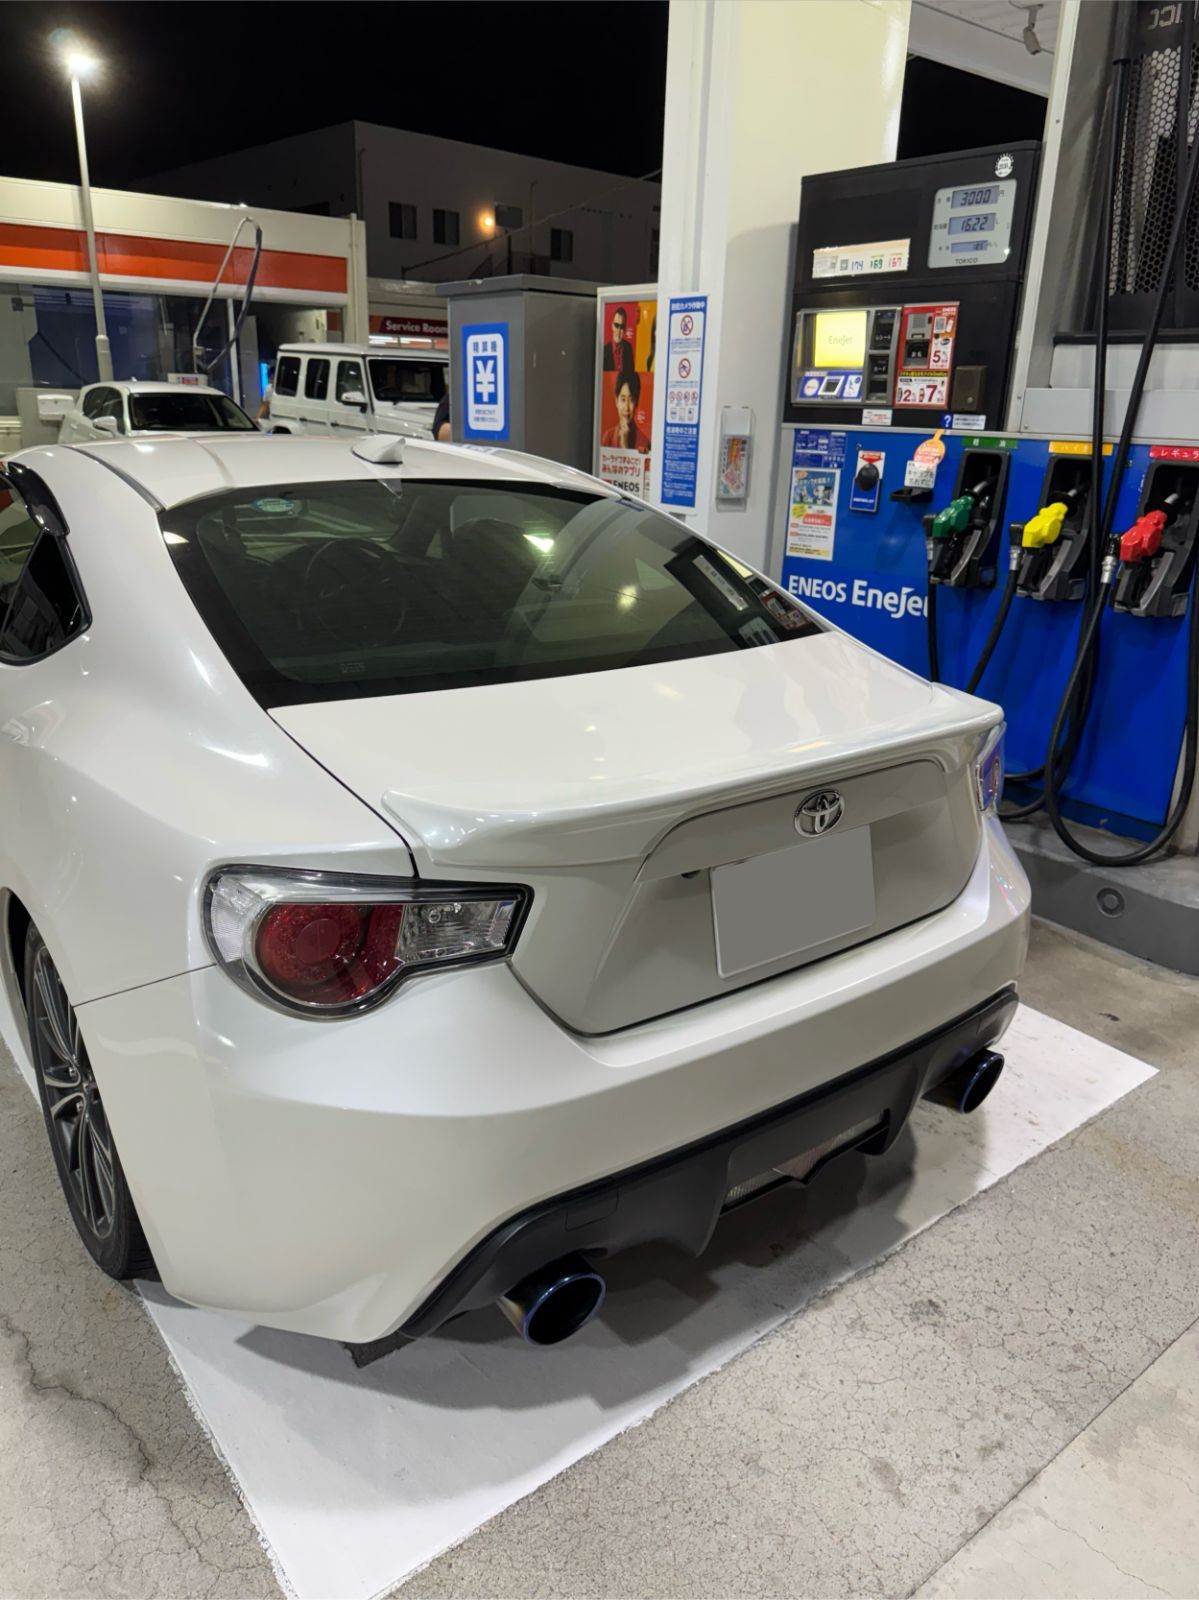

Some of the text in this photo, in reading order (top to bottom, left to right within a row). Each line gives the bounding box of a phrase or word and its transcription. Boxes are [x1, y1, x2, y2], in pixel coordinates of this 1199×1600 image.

[960, 189, 991, 207] 3000
[386, 320, 421, 332] Service
[932, 351, 941, 364] 5
[903, 384, 938, 402] 2 7
[1160, 448, 1199, 459] レギュラ
[613, 480, 640, 493] ENEOS
[788, 575, 847, 603] ENEOS
